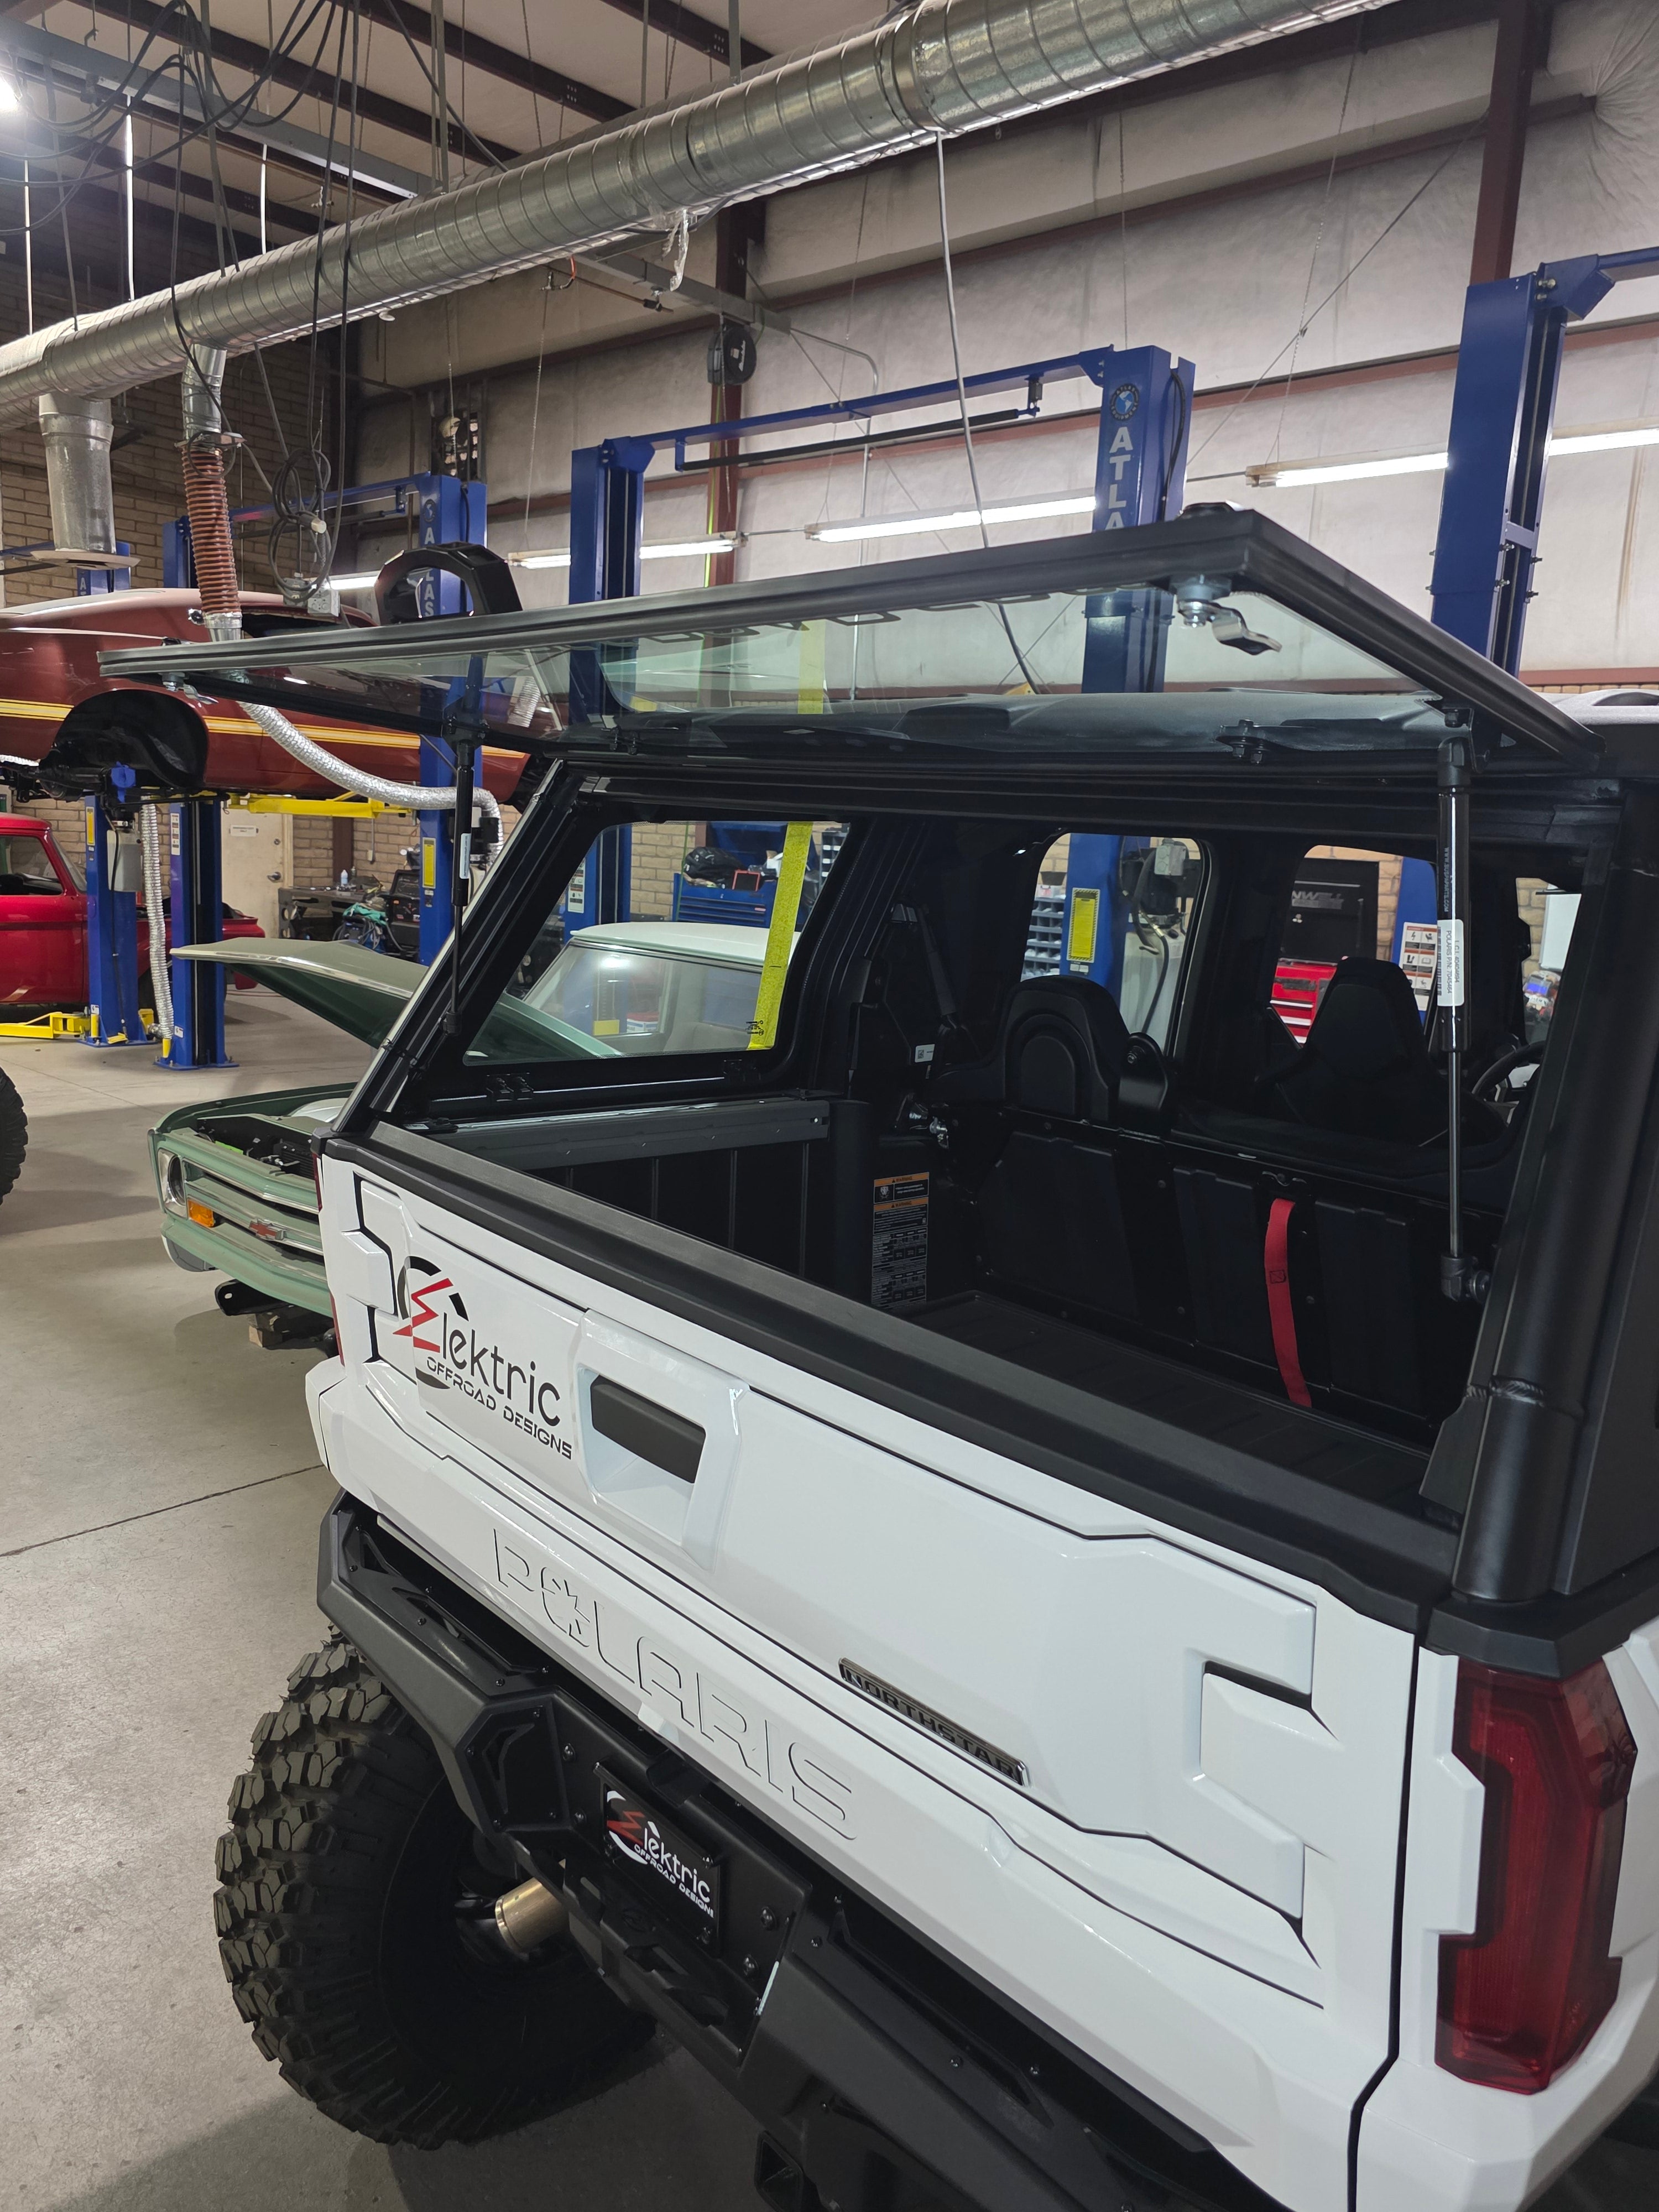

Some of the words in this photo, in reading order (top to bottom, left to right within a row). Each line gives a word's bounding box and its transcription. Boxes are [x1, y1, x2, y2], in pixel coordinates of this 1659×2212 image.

[424, 527, 435, 617] ALAS
[426, 1357, 497, 1411] OFFROAD
[503, 1406, 572, 1460] DESIGNS
[493, 1528, 857, 1840] POLARIS
[845, 1668, 1017, 1781] NORTHSTAR
[634, 1844, 676, 1885] OFFROAD
